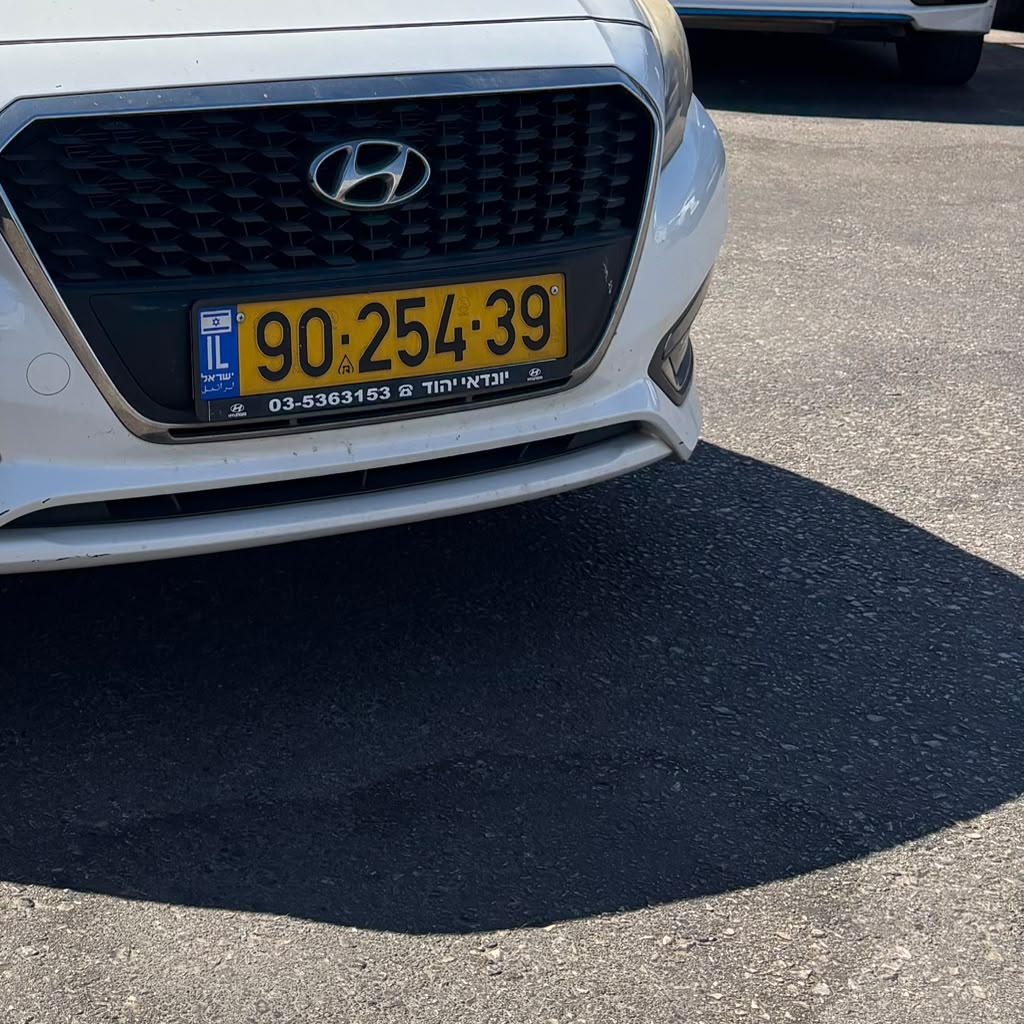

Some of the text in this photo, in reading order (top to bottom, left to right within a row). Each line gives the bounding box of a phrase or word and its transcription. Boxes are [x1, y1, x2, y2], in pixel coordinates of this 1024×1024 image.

[206, 335, 229, 370] IL
[200, 372, 235, 383] ישראל
[421, 370, 510, 395] יונדאי יהוד
[268, 386, 391, 413] 03-5363153
